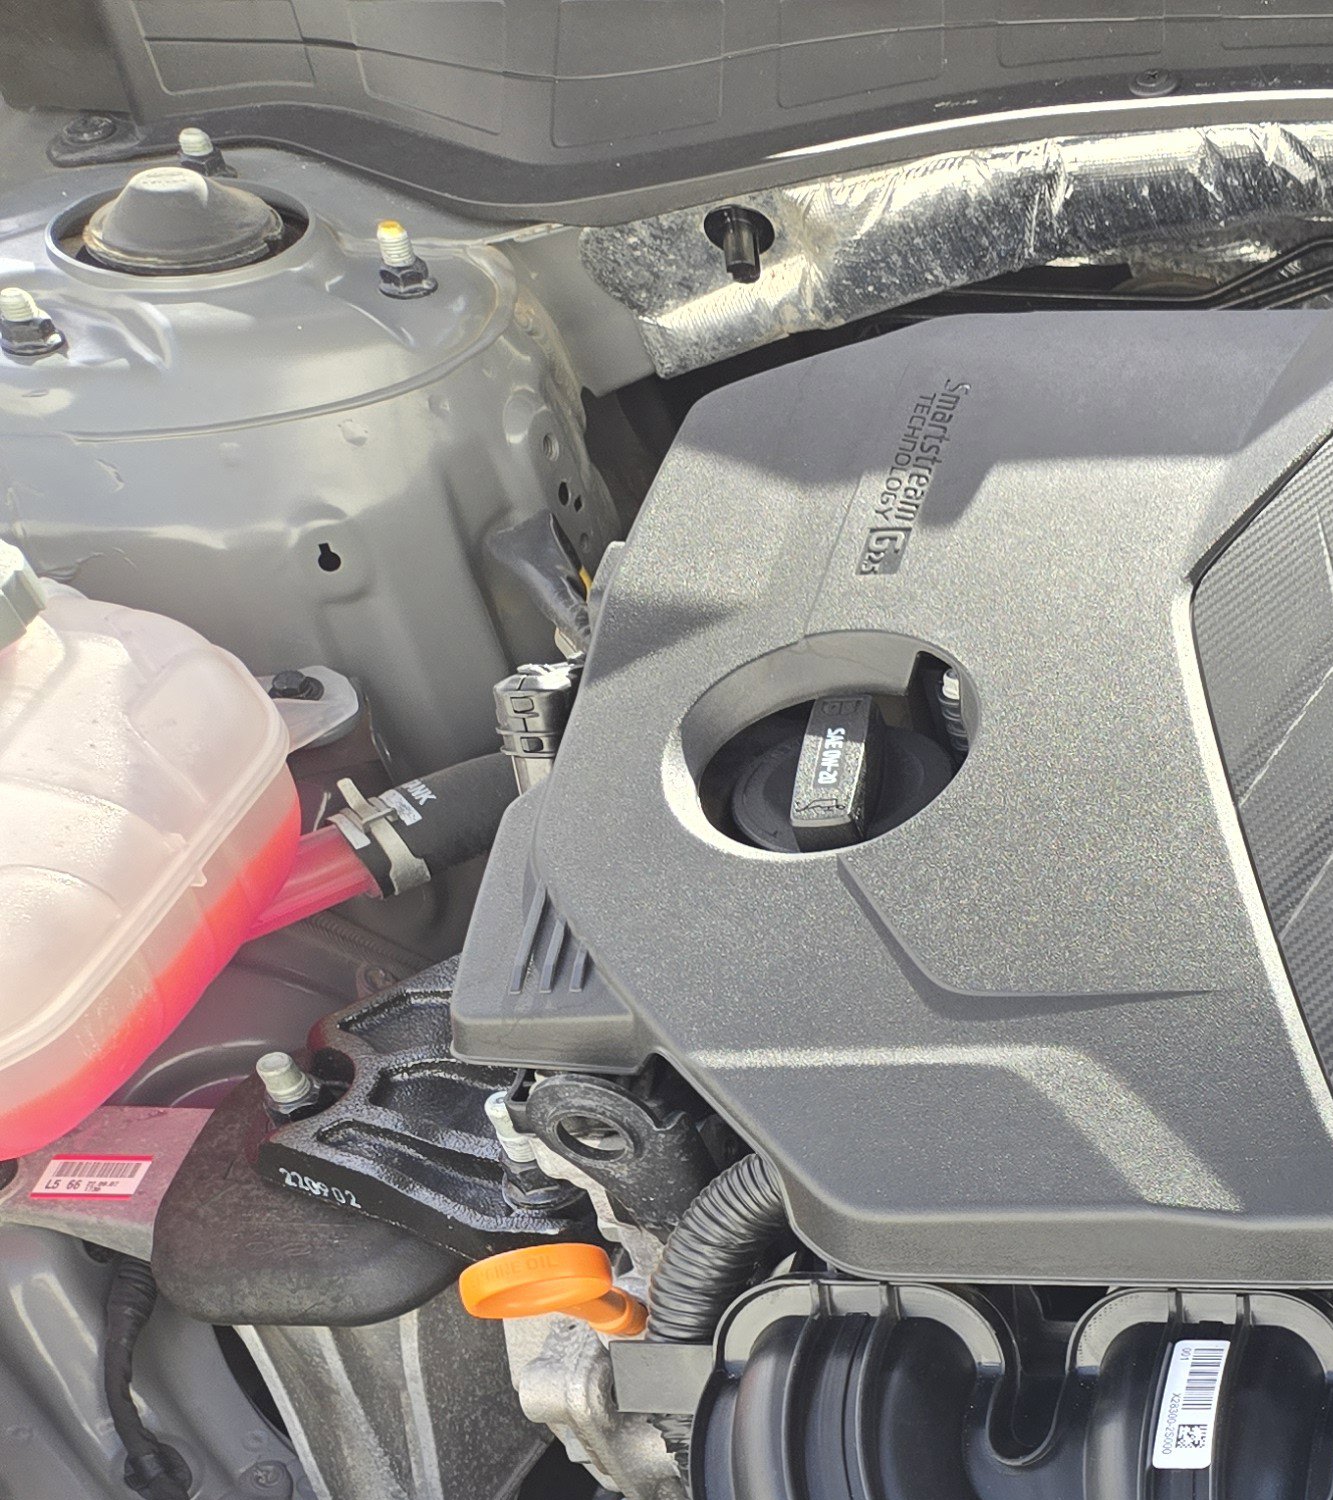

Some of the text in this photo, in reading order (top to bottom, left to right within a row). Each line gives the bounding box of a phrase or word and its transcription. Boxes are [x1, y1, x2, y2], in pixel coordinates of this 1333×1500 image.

[875, 393, 937, 522] TECHNOLOGY
[894, 378, 972, 524] Smartstream
[817, 727, 846, 785] SAE 0W-20
[400, 779, 437, 806] ANK
[66, 1179, 82, 1190] 66
[278, 1167, 362, 1209] 220902
[526, 1255, 558, 1271] OIL
